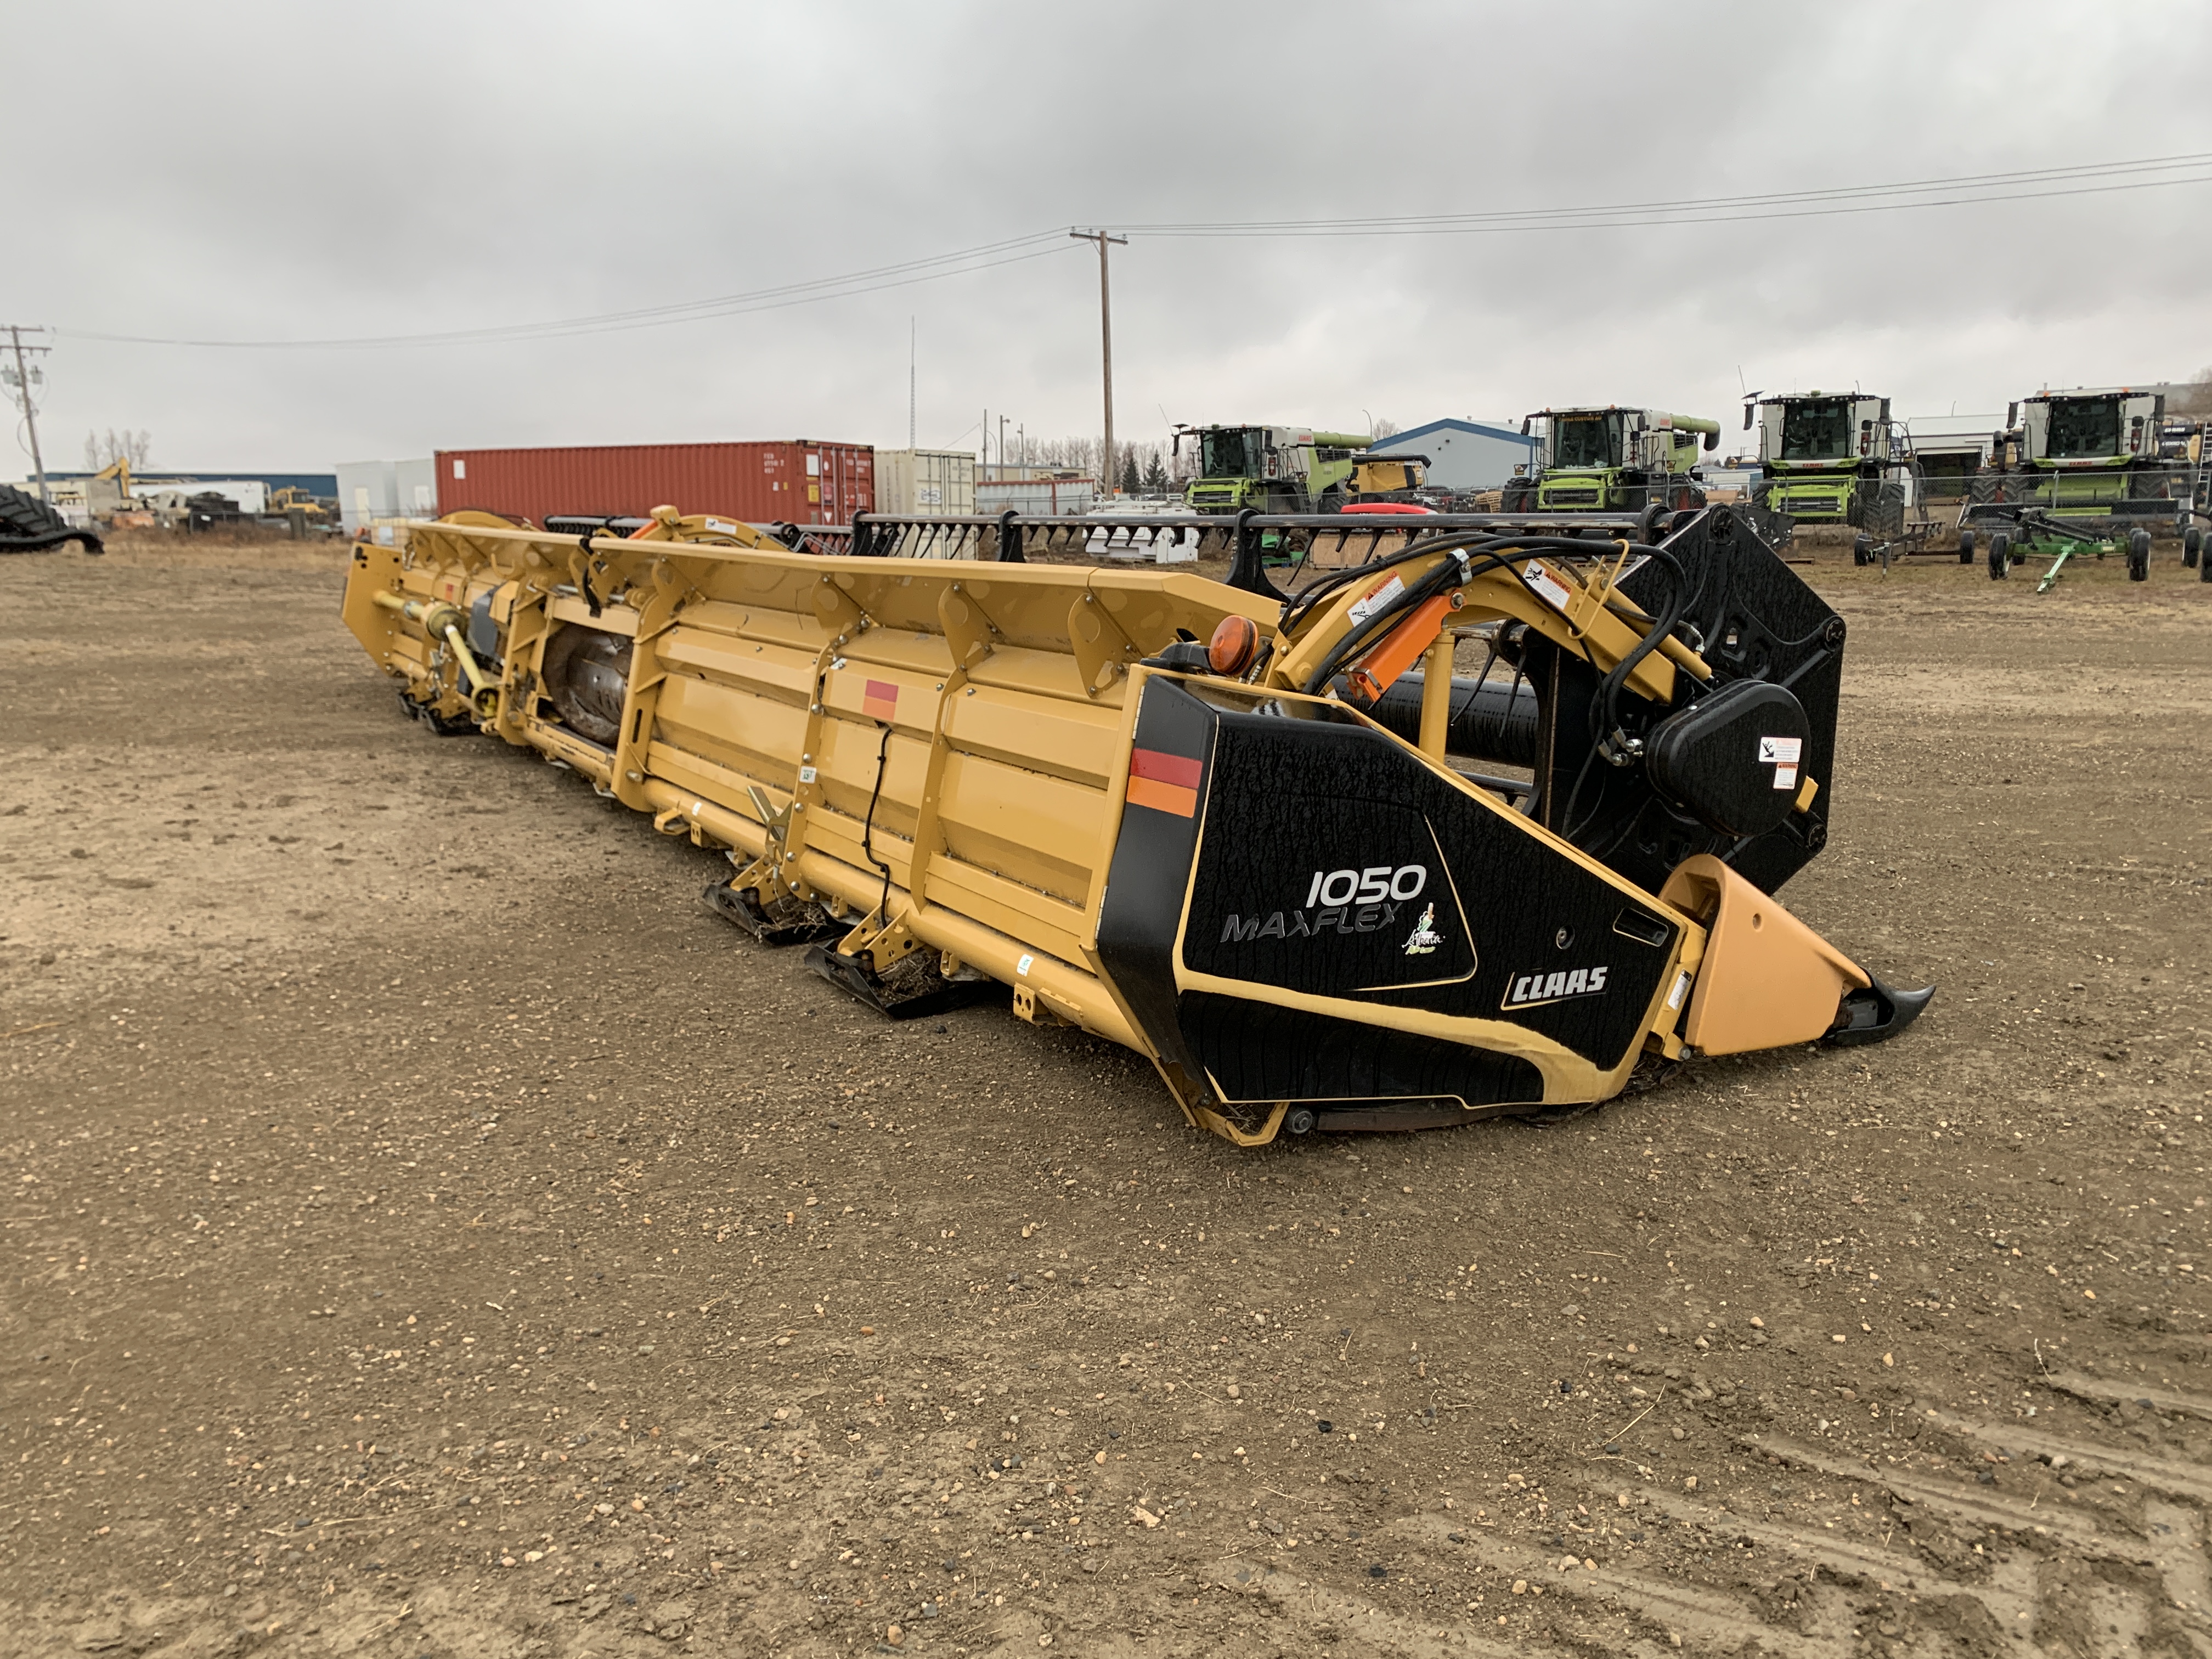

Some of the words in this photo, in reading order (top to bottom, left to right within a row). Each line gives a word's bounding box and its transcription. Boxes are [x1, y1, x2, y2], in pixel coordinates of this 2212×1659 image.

[1373, 571, 1397, 593] WARNING
[1550, 574, 1571, 592] WARNING
[1306, 865, 1426, 908] 1050
[1220, 902, 1403, 943] MAXFLEX
[1513, 967, 1608, 1002] CLAAS
